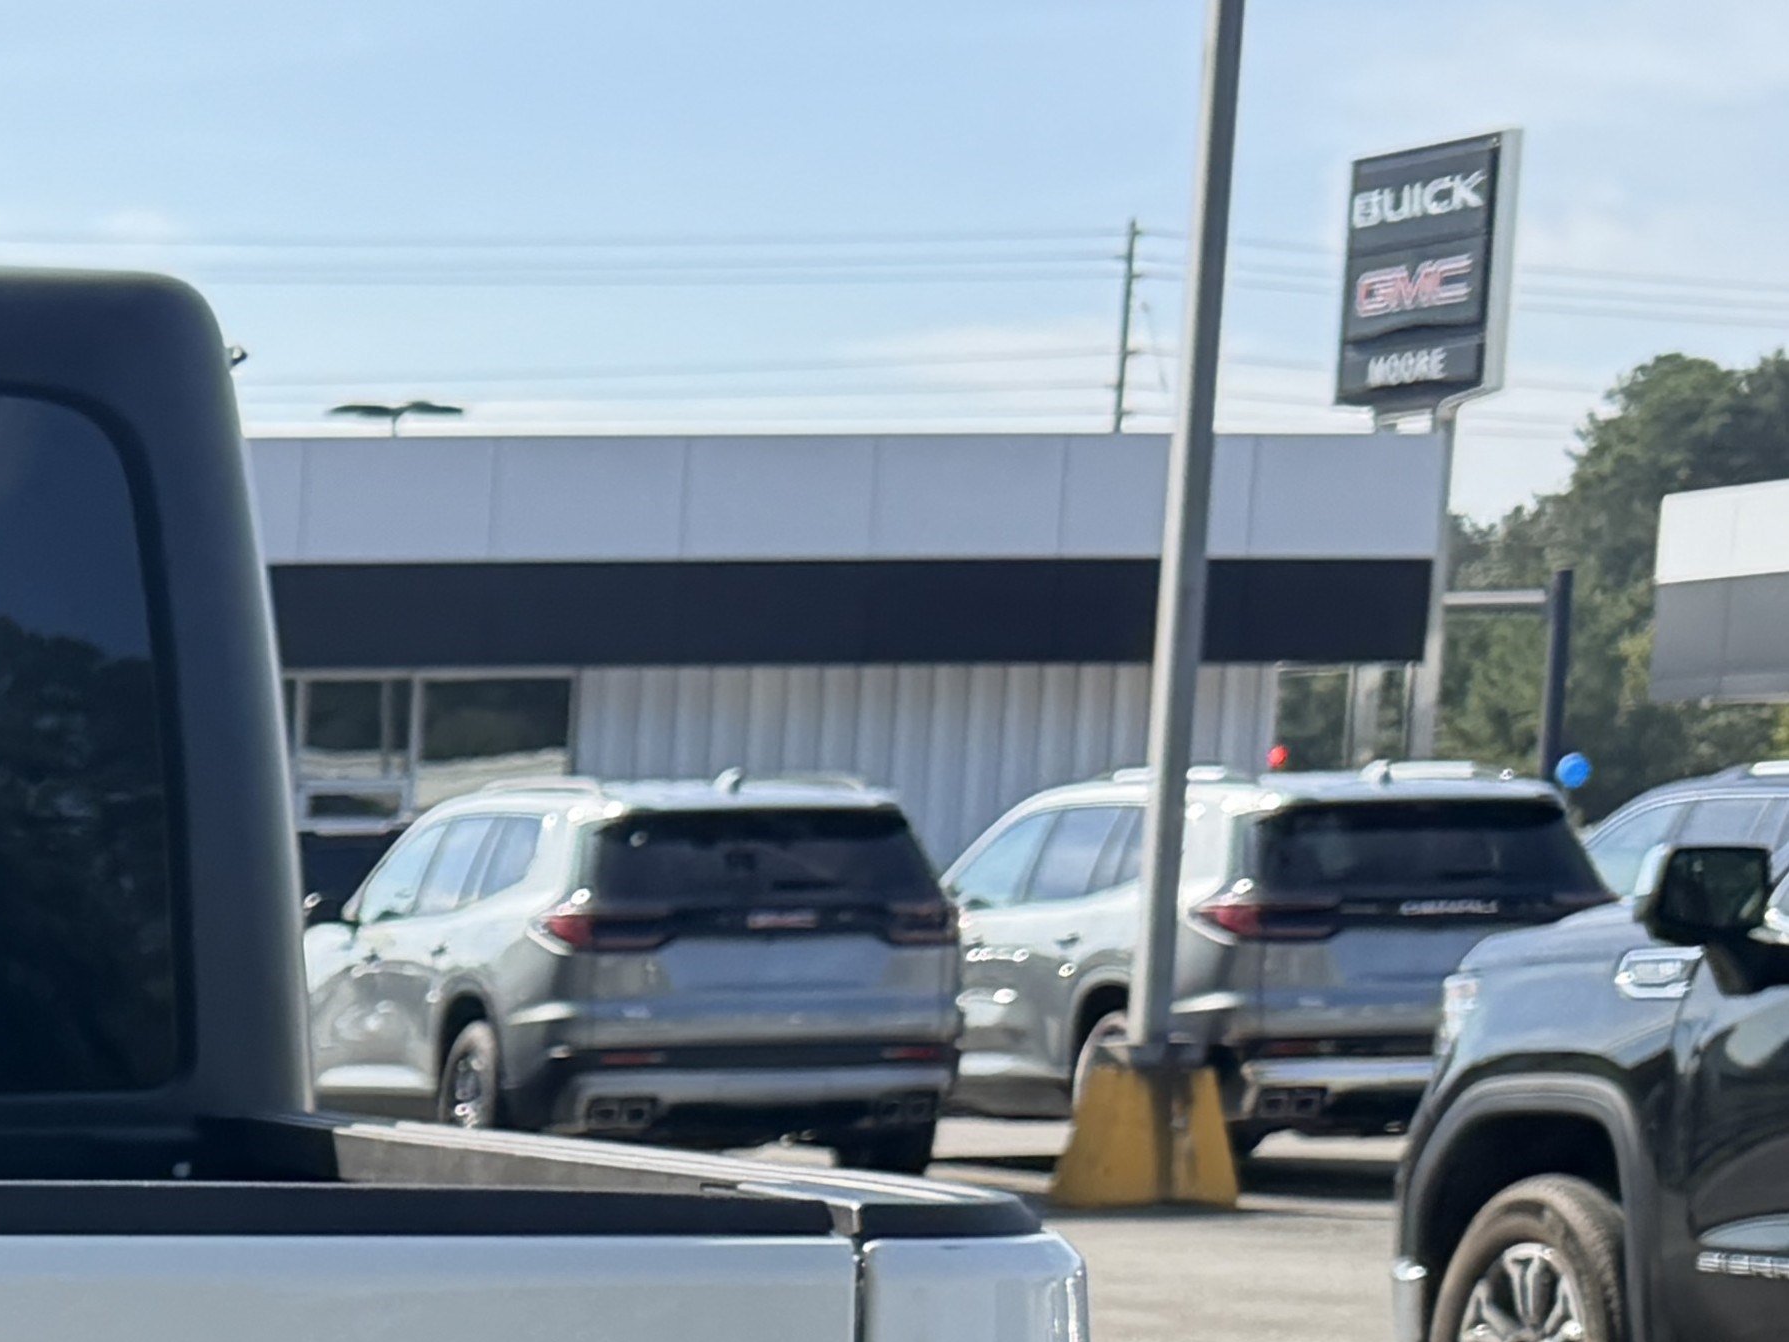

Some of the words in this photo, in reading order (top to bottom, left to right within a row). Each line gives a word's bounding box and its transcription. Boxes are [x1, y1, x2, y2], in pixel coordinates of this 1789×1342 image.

[1352, 171, 1486, 228] BUICK
[1356, 254, 1472, 317] GMC
[1367, 348, 1446, 386] MOORE
